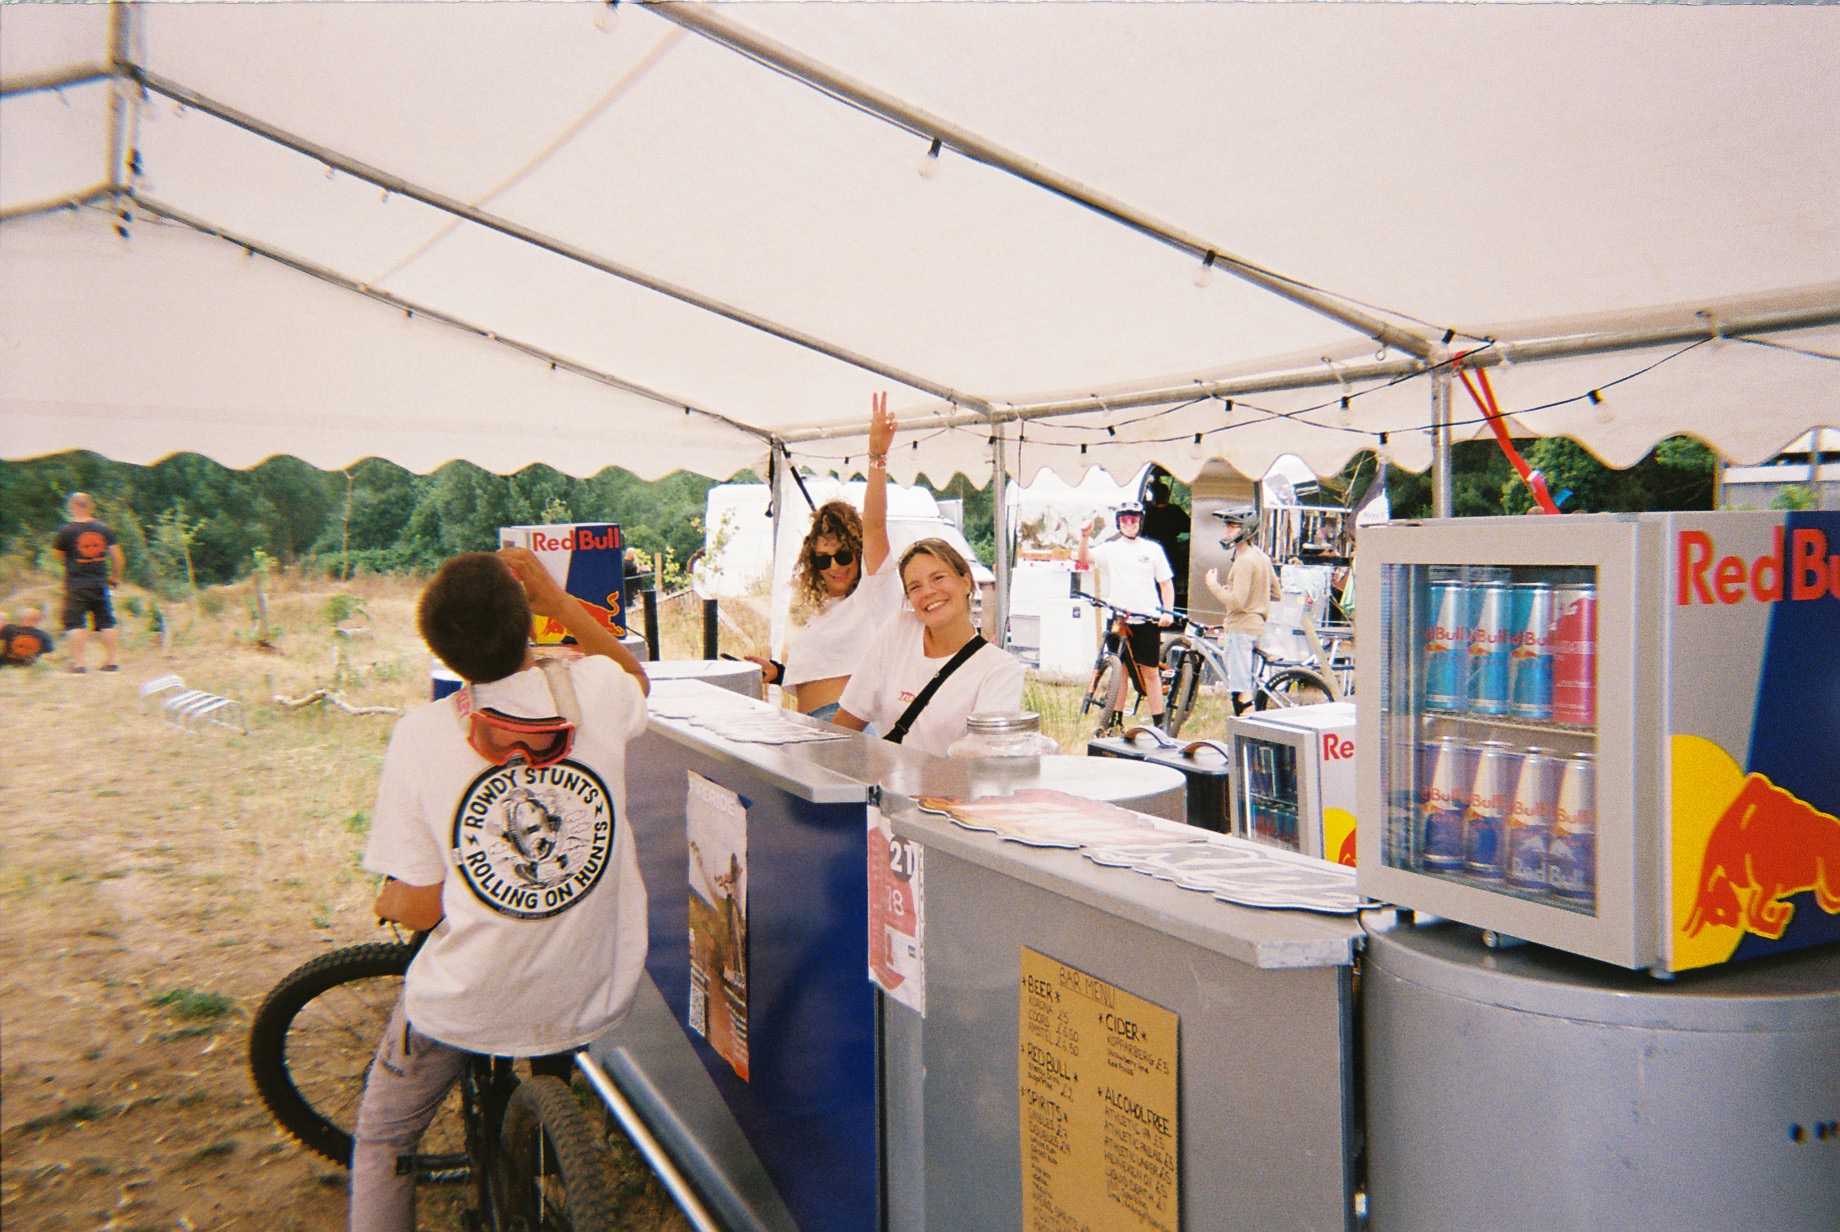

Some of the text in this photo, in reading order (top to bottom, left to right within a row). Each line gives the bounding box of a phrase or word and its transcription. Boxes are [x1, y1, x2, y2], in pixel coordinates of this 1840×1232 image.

[532, 528, 619, 552] Red Bull
[1677, 525, 1784, 606] Red
[1322, 733, 1355, 761] Re
[464, 767, 599, 829] ROWDY STUNTS
[466, 820, 608, 909] ROLLING ON HUNTS
[889, 841, 912, 875] 21
[884, 886, 905, 916] 18
[1028, 974, 1052, 1002] BEER
[1060, 967, 1115, 1007] BAR MENU
[1105, 1013, 1140, 1041] CIDER
